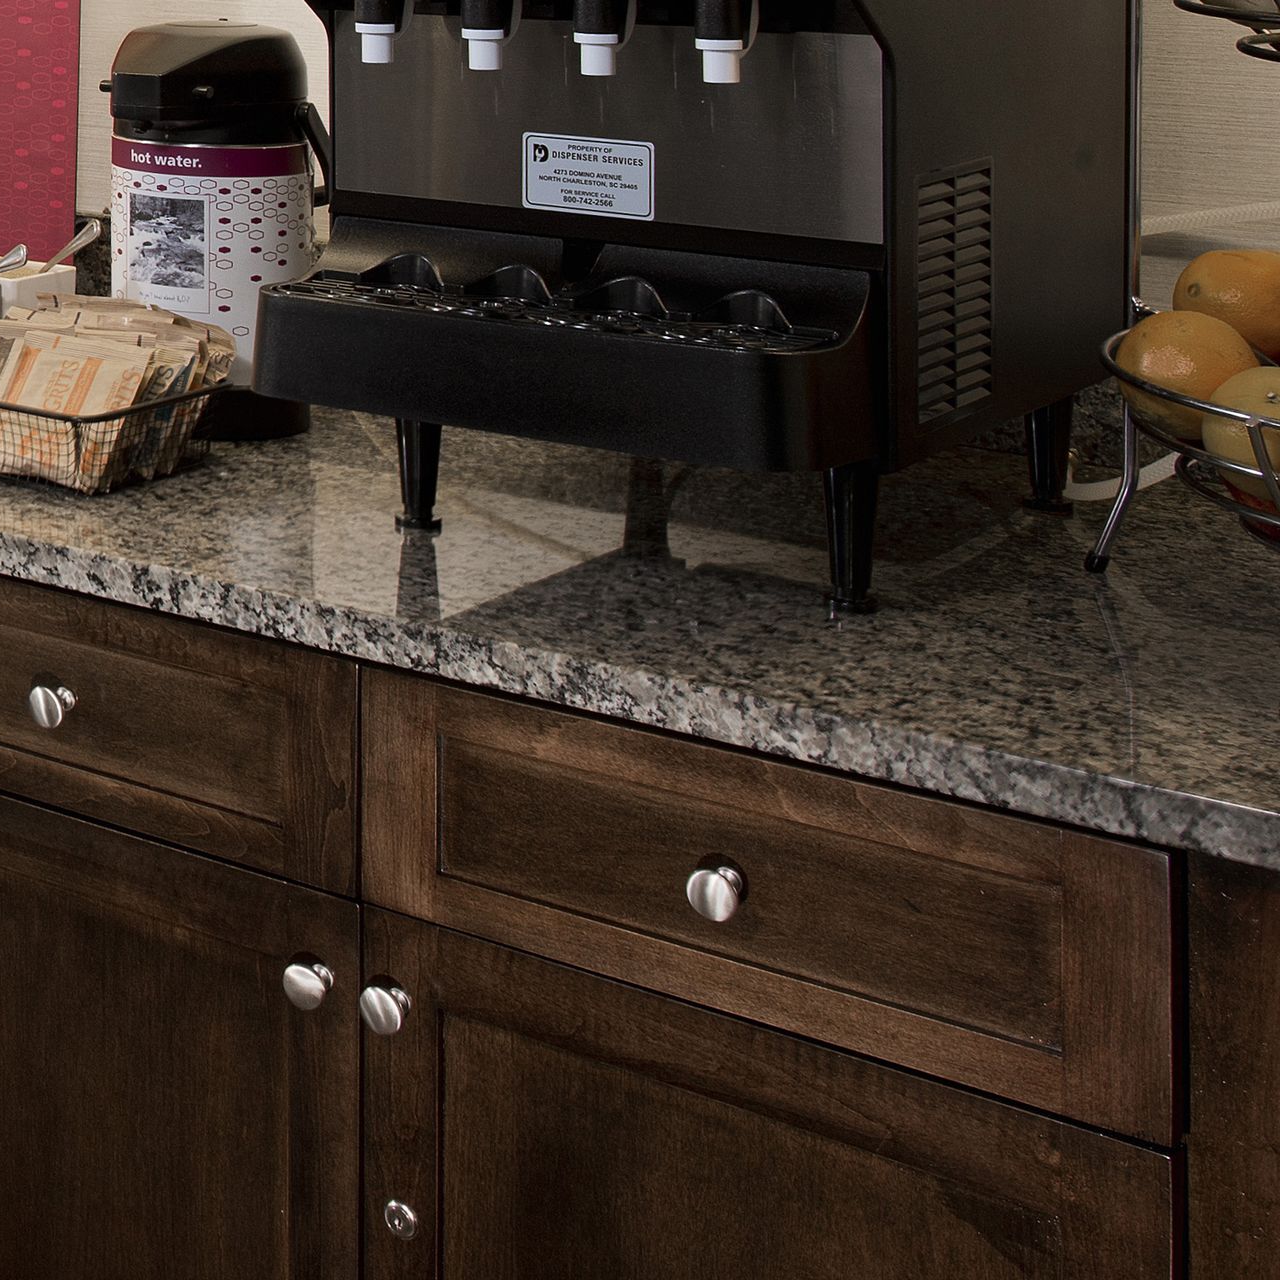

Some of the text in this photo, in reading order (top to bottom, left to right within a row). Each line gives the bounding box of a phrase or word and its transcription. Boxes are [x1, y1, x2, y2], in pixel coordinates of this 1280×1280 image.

[568, 144, 602, 153] PROPERTY
[131, 149, 202, 168] hot water.
[552, 150, 644, 166] DISPENSER SERVICES
[569, 170, 595, 178] DOMINO
[596, 173, 622, 181] AVENUE
[562, 177, 608, 188] CHARLESTON,
[574, 190, 599, 198] SERVICE
[563, 196, 613, 207] 800-742-2566
[43, 360, 80, 411] GRITS
